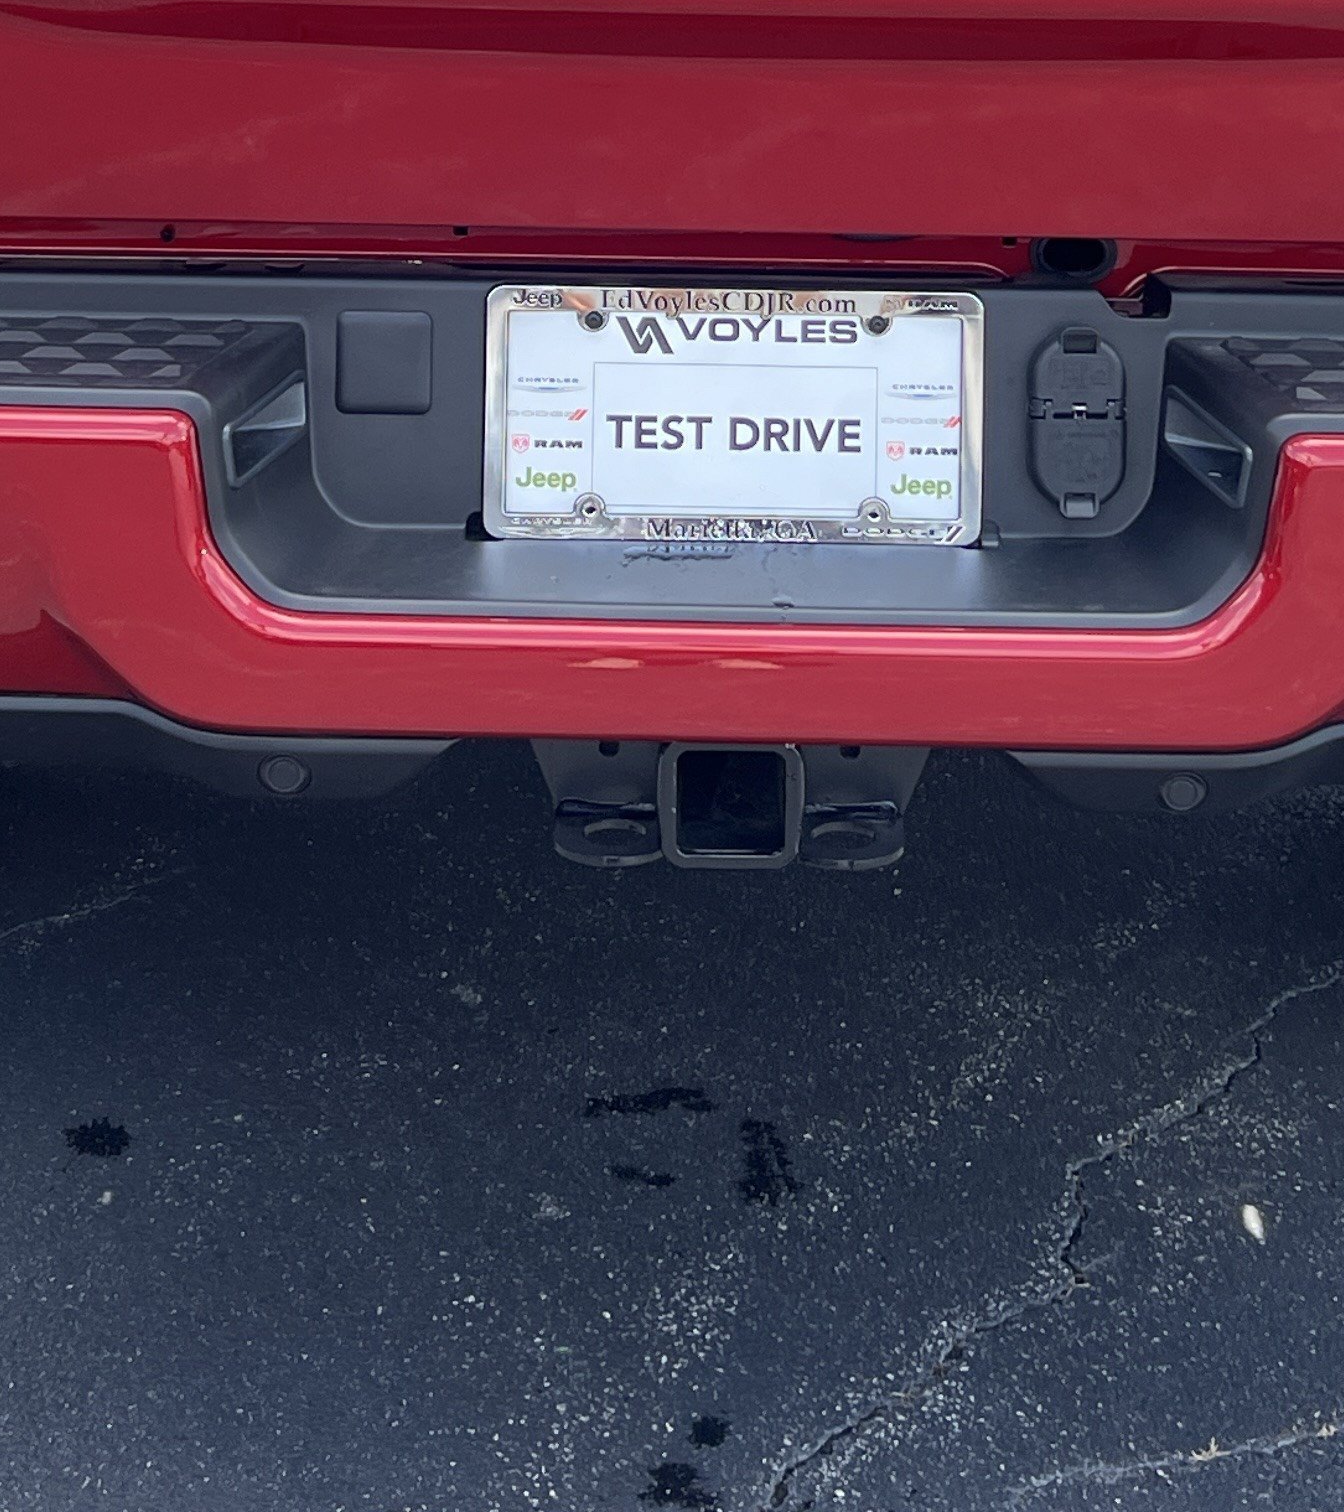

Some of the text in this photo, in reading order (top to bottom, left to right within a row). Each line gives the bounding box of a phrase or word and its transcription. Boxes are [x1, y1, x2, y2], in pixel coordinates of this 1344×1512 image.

[512, 287, 564, 308] Jeep
[601, 288, 857, 320] EdVoylesCDJR.com
[676, 316, 858, 344] VOYLES
[534, 439, 584, 449] RAM
[605, 414, 862, 453] TEST DRIVE
[909, 446, 958, 456] RAM
[515, 466, 577, 492] Jeep
[889, 473, 953, 500] Jeep
